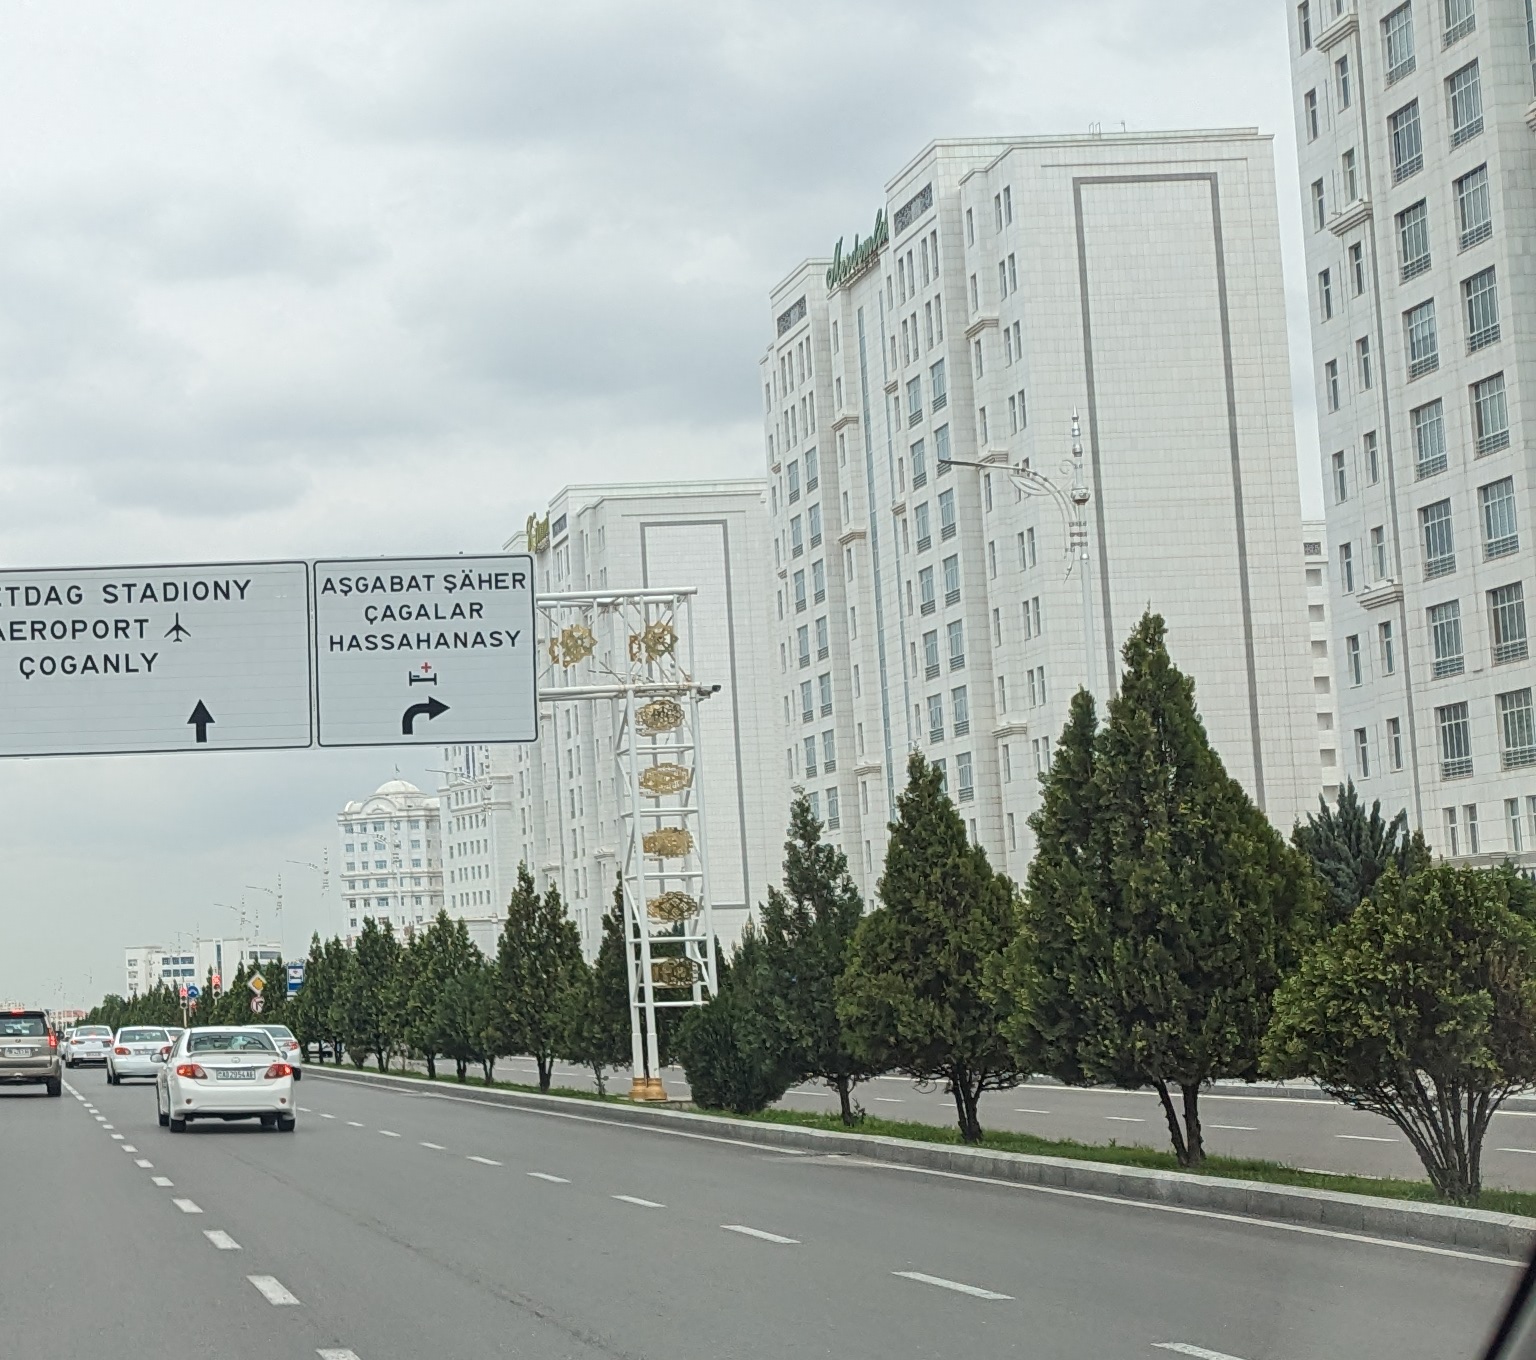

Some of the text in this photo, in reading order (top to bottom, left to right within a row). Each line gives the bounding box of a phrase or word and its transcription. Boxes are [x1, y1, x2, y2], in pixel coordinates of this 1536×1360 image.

[102, 579, 252, 604] STADIONY
[320, 569, 526, 597] AŞGABAT ŞÄHER
[364, 601, 484, 625] ÇAGALAR
[329, 629, 521, 652] HASSAHANASY
[19, 652, 159, 680] ÇOGANLY
